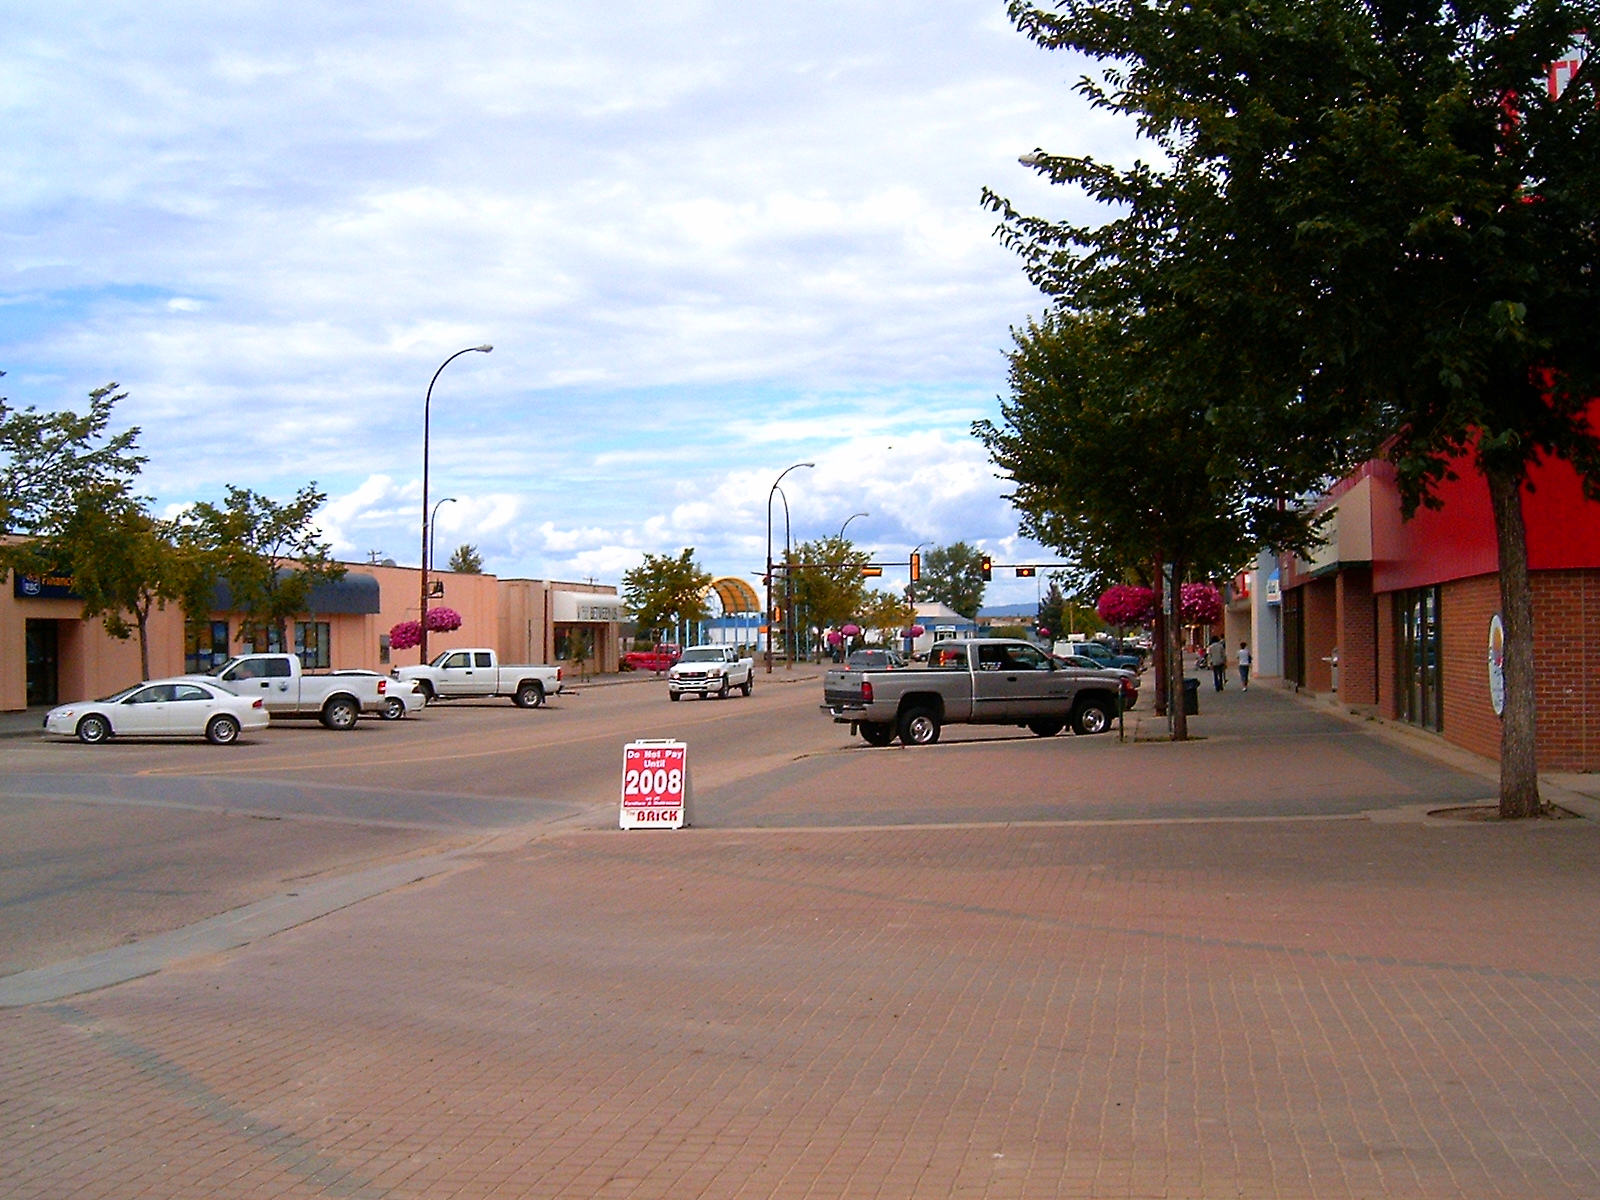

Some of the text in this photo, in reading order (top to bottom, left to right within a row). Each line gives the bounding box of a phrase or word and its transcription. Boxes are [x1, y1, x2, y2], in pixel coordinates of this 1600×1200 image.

[627, 750, 683, 760] Do Not Pay
[643, 759, 666, 768] Until
[625, 769, 682, 795] 2008
